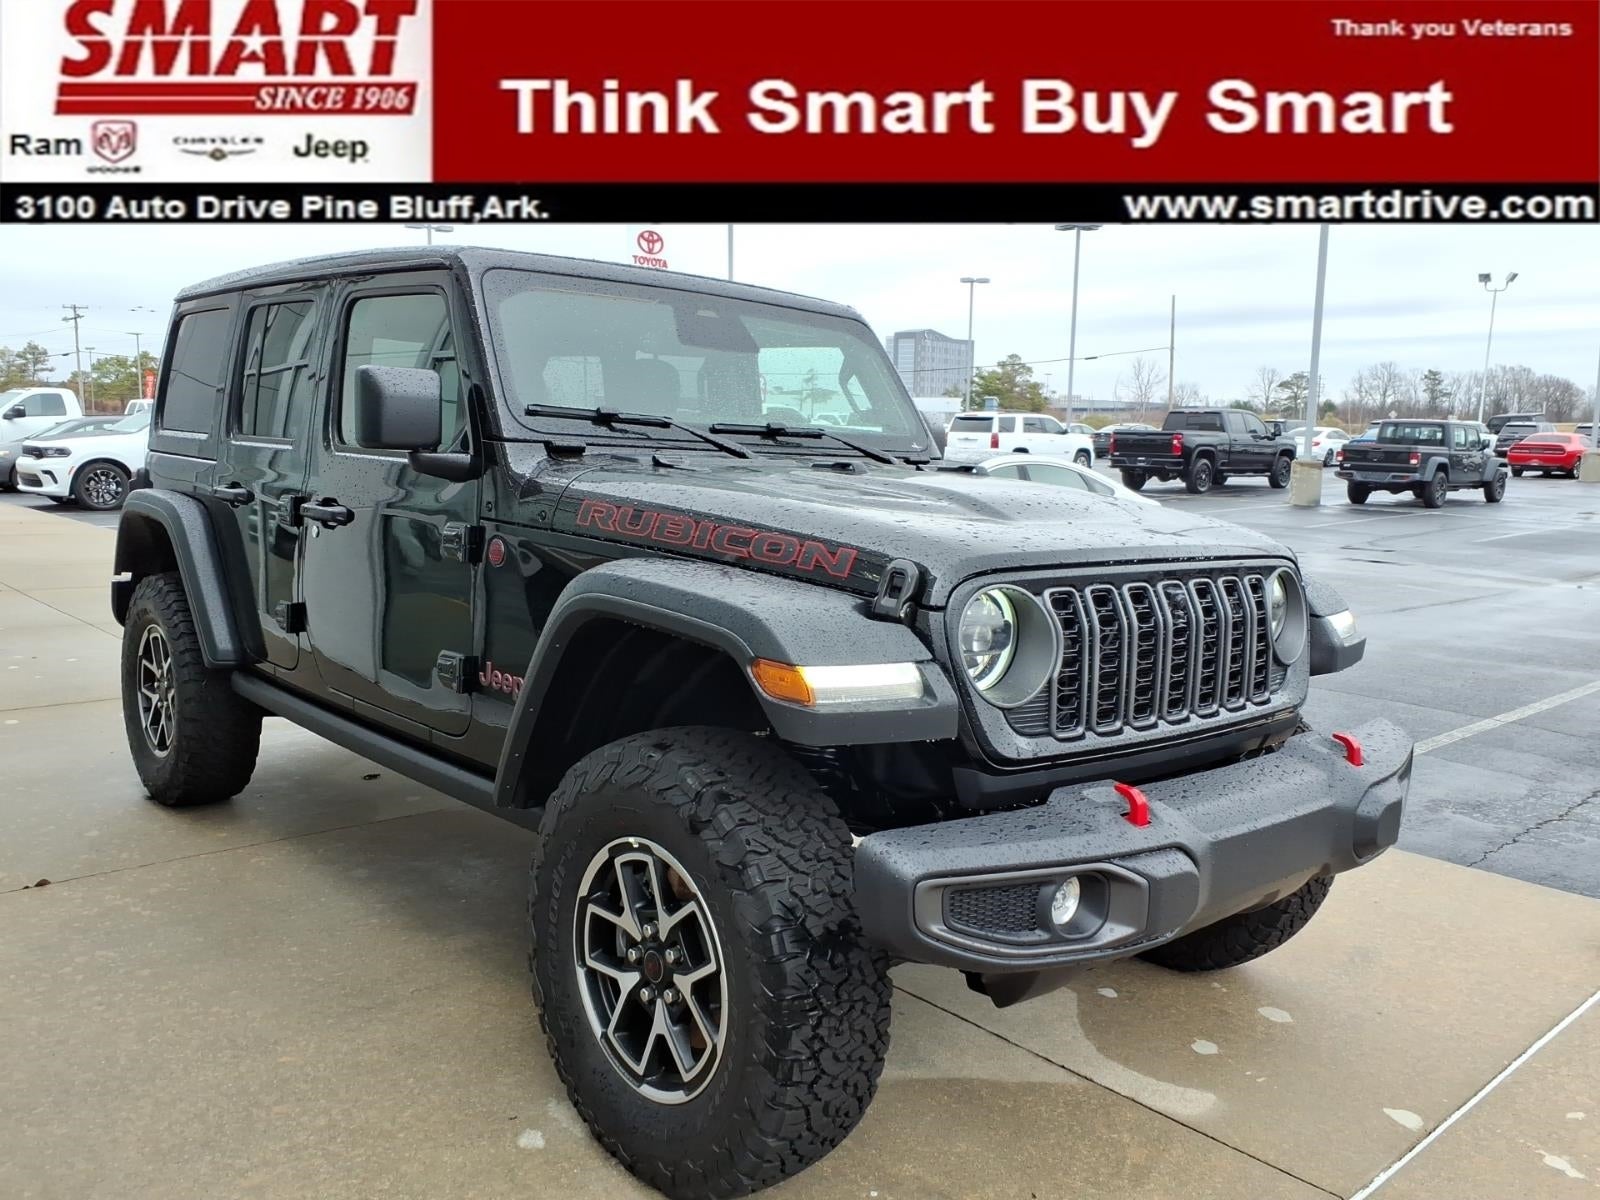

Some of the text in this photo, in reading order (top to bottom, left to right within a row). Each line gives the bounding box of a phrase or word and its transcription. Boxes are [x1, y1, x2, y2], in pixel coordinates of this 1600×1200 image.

[632, 255, 668, 269] TOYOTA
[577, 499, 858, 578] RUBICON
[479, 661, 525, 701] Jeep
